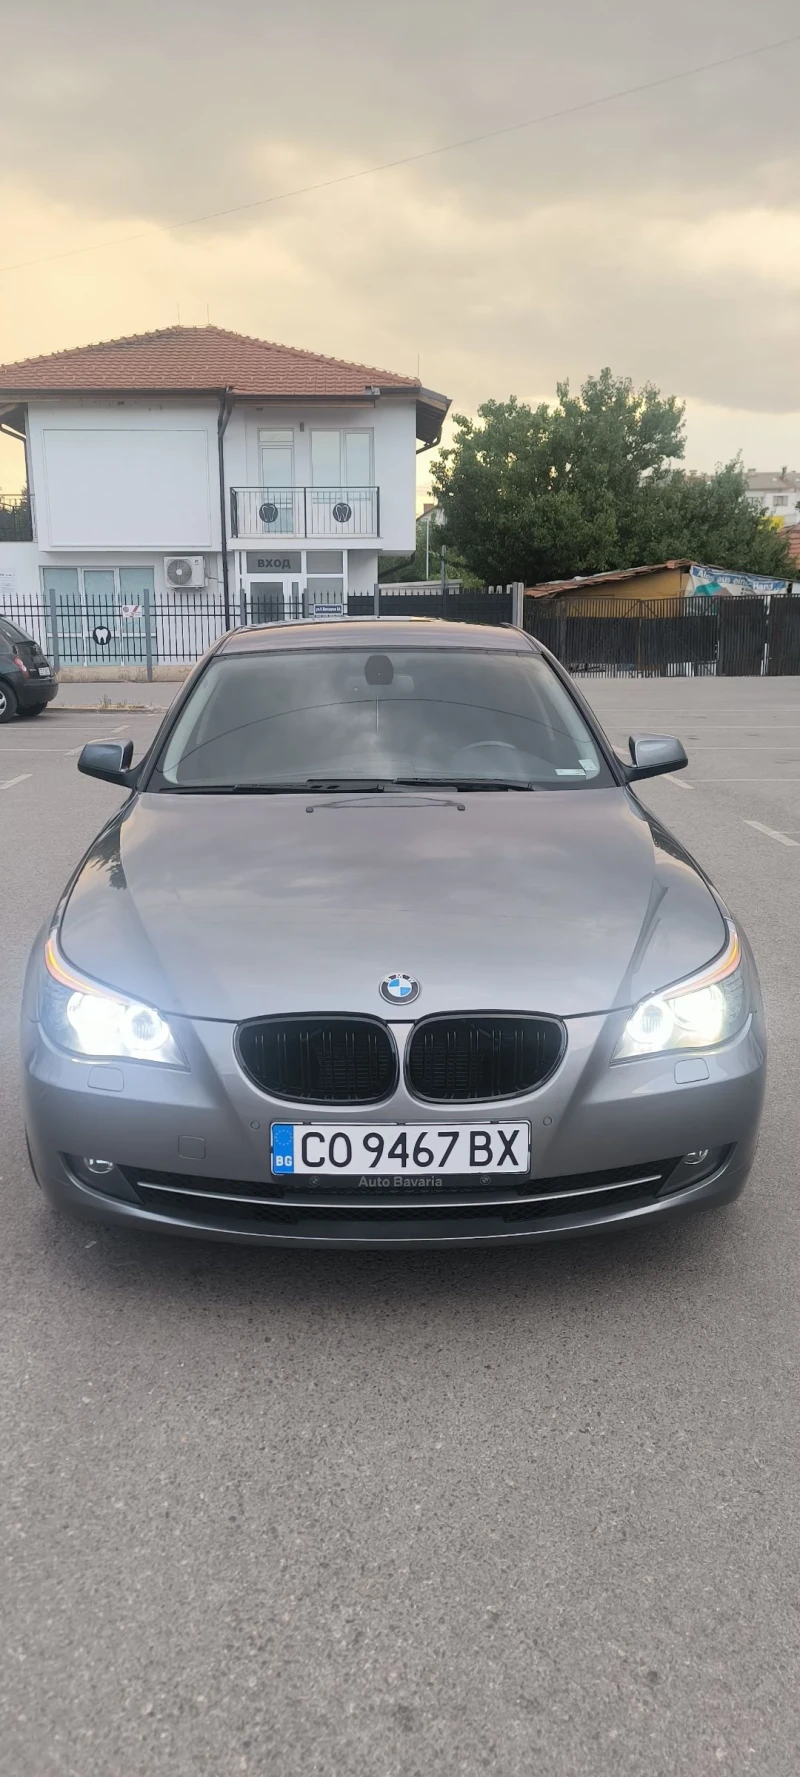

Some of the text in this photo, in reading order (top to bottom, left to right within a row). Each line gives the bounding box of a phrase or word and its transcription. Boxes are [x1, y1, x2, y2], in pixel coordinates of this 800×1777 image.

[257, 558, 291, 570] ВХОД
[362, 1130, 460, 1168] 9467
[469, 1129, 520, 1167] BX
[275, 1155, 293, 1167] BG
[358, 1175, 443, 1188] Auto Bavaria
